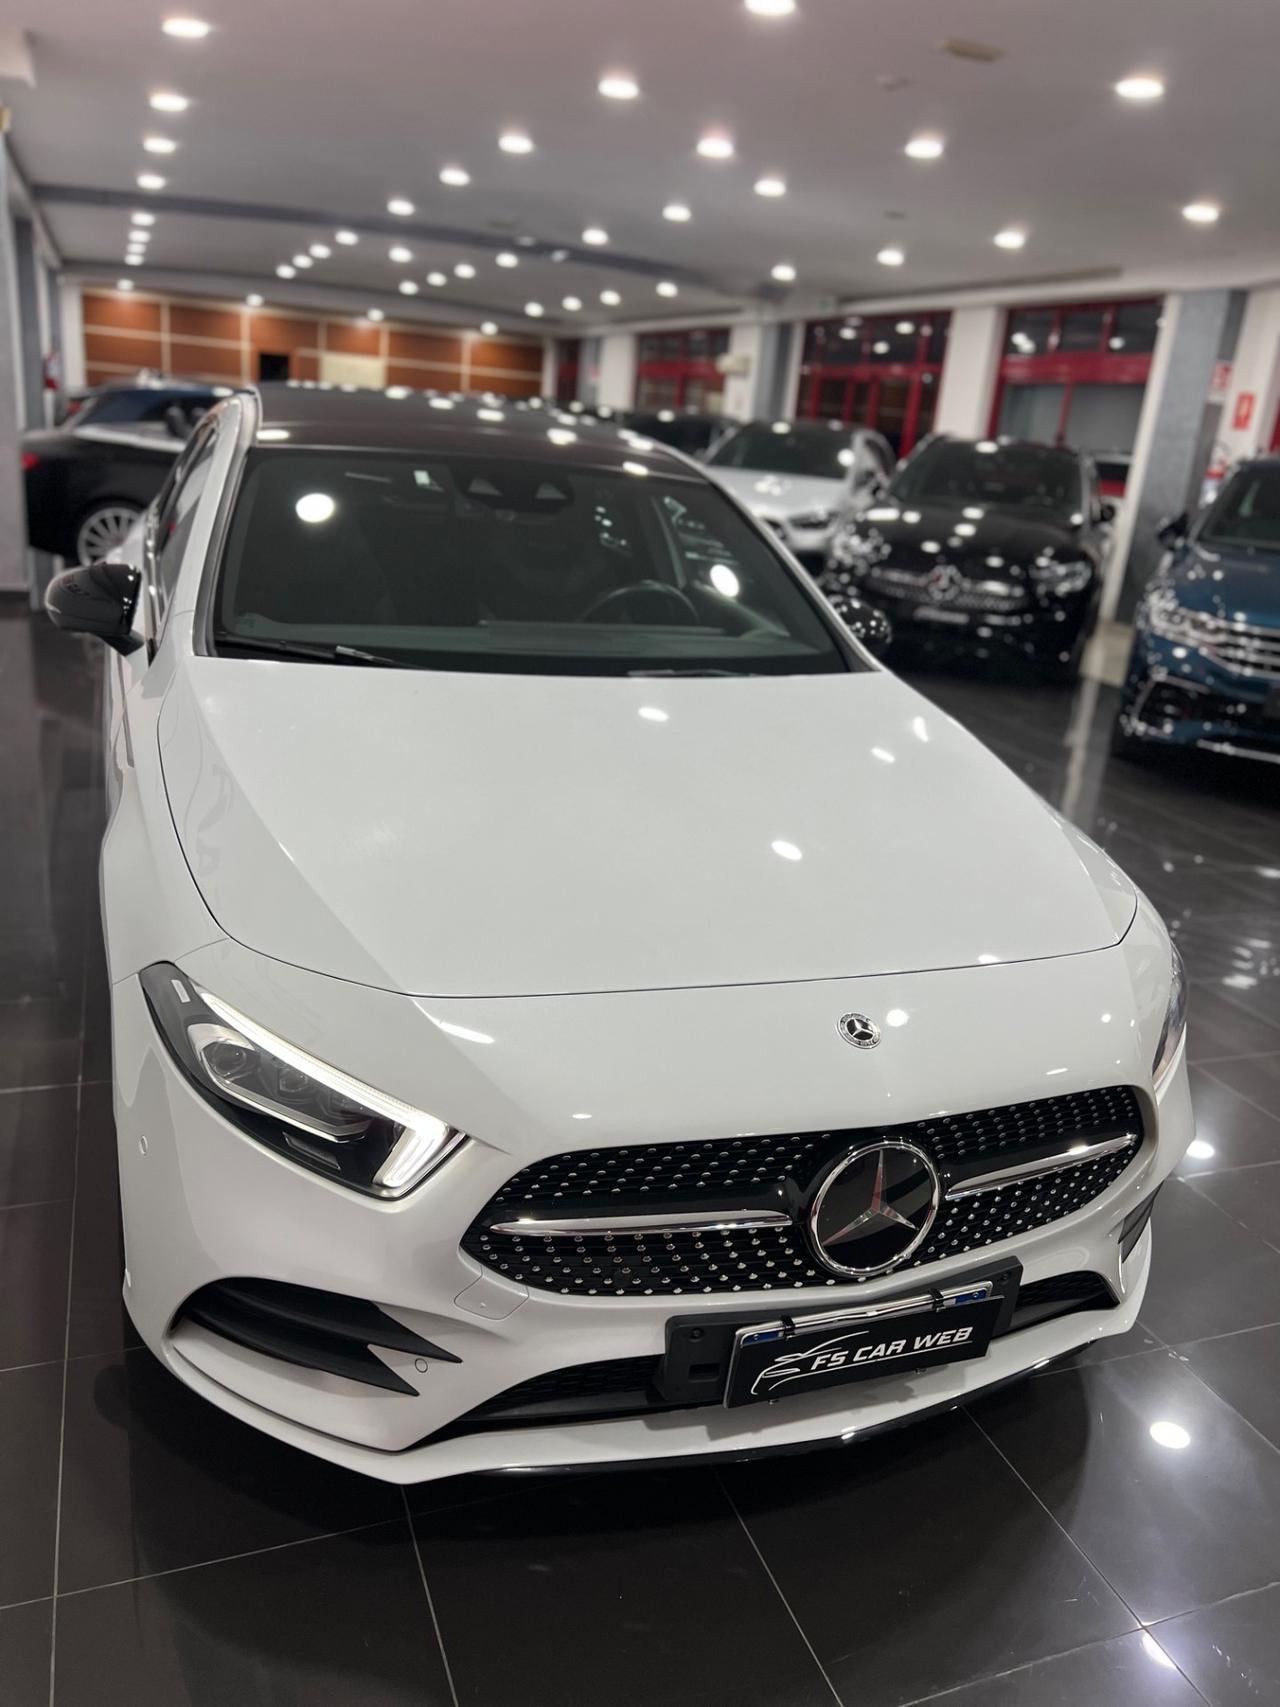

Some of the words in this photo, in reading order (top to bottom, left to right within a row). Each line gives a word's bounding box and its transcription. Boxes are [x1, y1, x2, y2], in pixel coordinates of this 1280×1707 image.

[811, 1350, 849, 1370] FS
[853, 1339, 907, 1362] CAR
[913, 1326, 973, 1350] WEB
